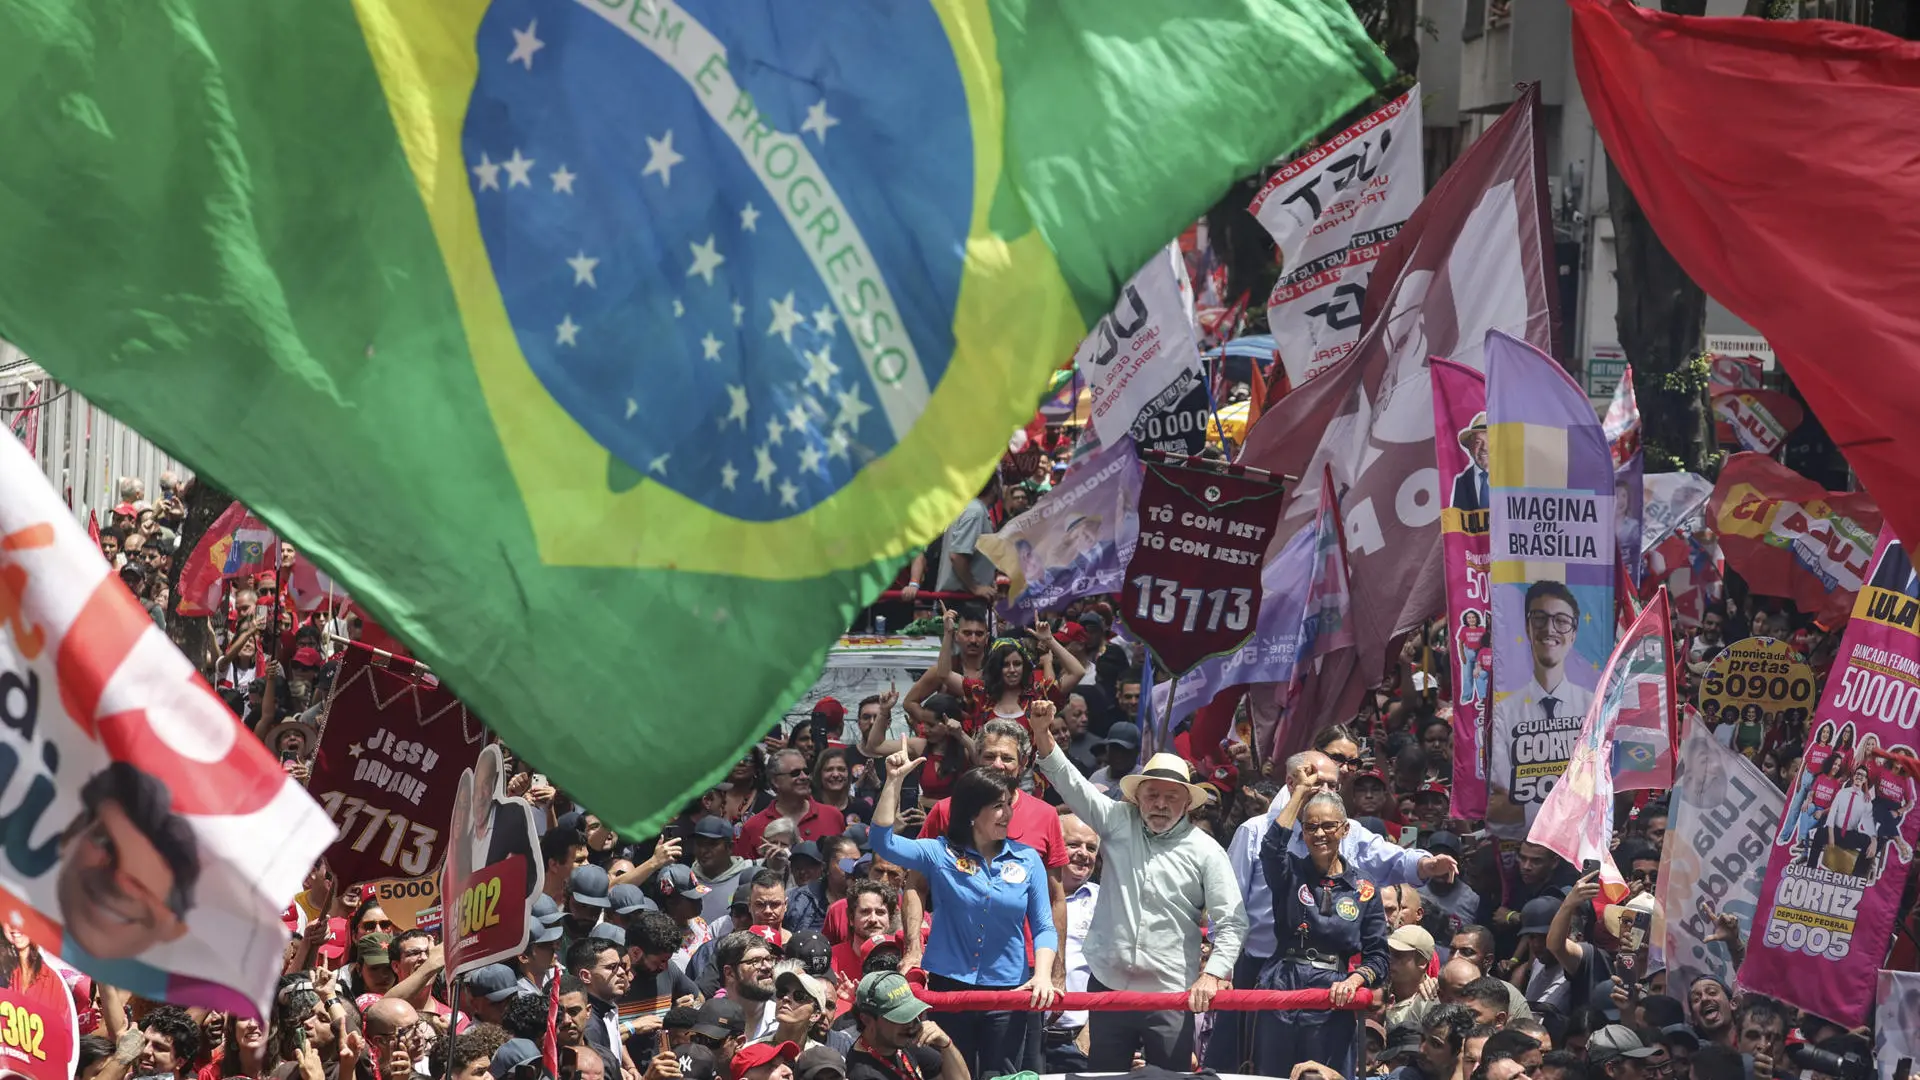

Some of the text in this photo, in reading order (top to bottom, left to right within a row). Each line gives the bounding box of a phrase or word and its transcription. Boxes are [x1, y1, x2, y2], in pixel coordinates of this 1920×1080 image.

[598, 0, 908, 385] EM E PROGRESSO
[1148, 504, 1266, 540] TÔ COM MST
[1507, 496, 1598, 523] IMAGINA
[1533, 520, 1558, 533] em
[1140, 531, 1261, 566] TÔ COM JESSY
[1508, 529, 1598, 559] BRASÍLIA
[1466, 567, 1490, 603] 50
[1132, 575, 1252, 632] 13713
[1866, 590, 1920, 629] LULA
[1728, 660, 1790, 674] pretas
[1731, 649, 1774, 660] monica
[1852, 644, 1888, 666] BANCADA
[1705, 670, 1810, 702] 50900
[1833, 666, 1920, 729] 50000
[1517, 716, 1586, 734] GUILHERM
[367, 728, 439, 773] JESSY
[1516, 730, 1579, 763] CORTE
[353, 758, 428, 806] DAYANE
[1520, 765, 1563, 775] DEPUTADO
[1514, 774, 1560, 802] 50
[320, 790, 439, 876] 13713
[380, 877, 442, 900] 5000
[1786, 864, 1867, 889] GUILHERME
[458, 877, 501, 937] 302
[1339, 903, 1356, 916] 180
[1779, 877, 1863, 918] CORTEZ
[1777, 910, 1848, 930] DEPUTADO FEDERAL
[1767, 919, 1852, 957] 5005
[0, 1001, 46, 1060] 302
[678, 1055, 693, 1072] NY
